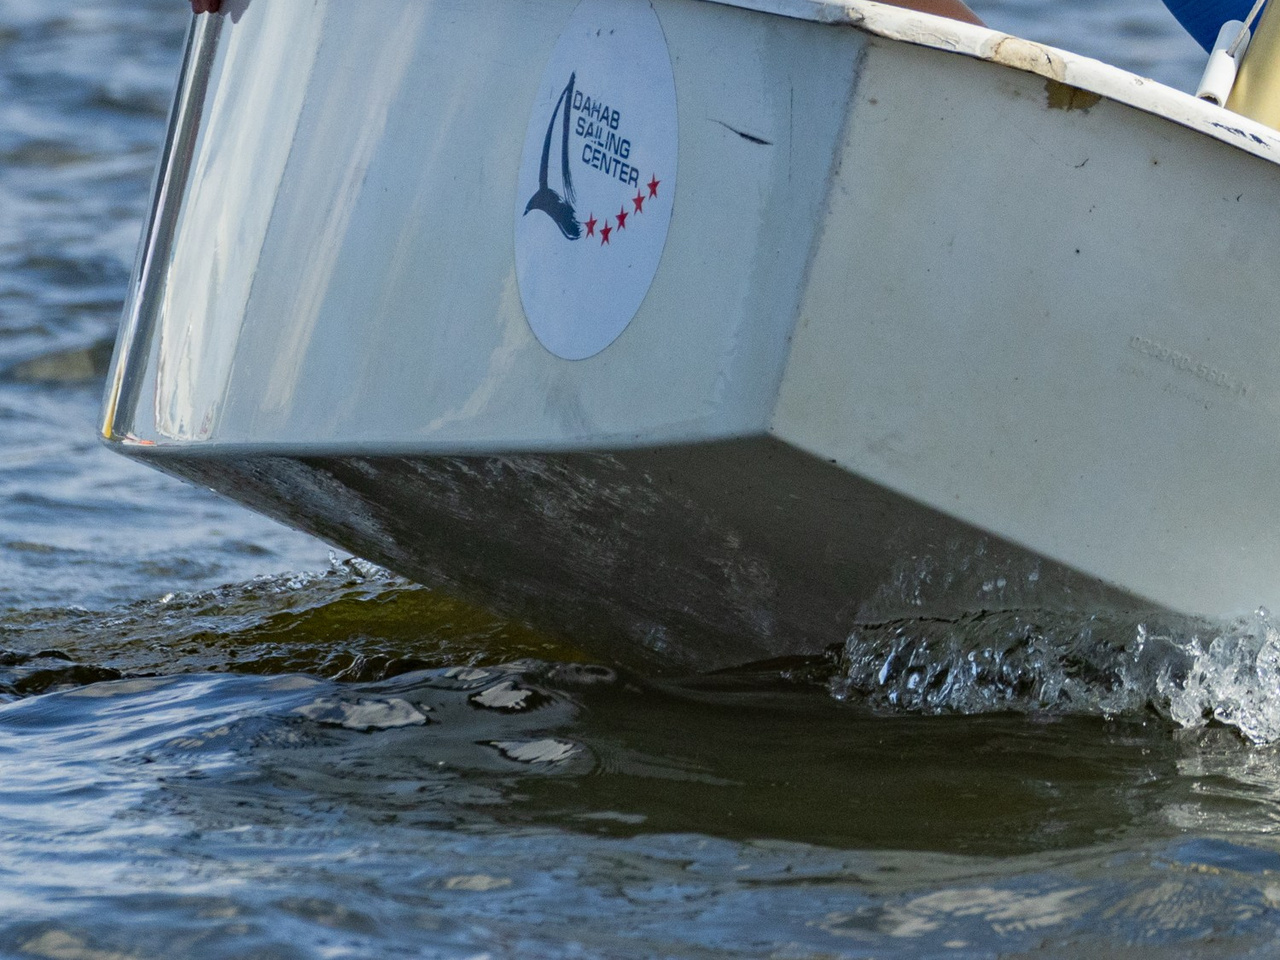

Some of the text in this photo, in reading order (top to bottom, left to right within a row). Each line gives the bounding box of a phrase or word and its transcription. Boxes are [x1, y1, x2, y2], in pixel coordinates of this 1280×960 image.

[572, 90, 621, 131] DAHAB
[575, 116, 631, 160] SAILING
[582, 144, 640, 189] CENTER
